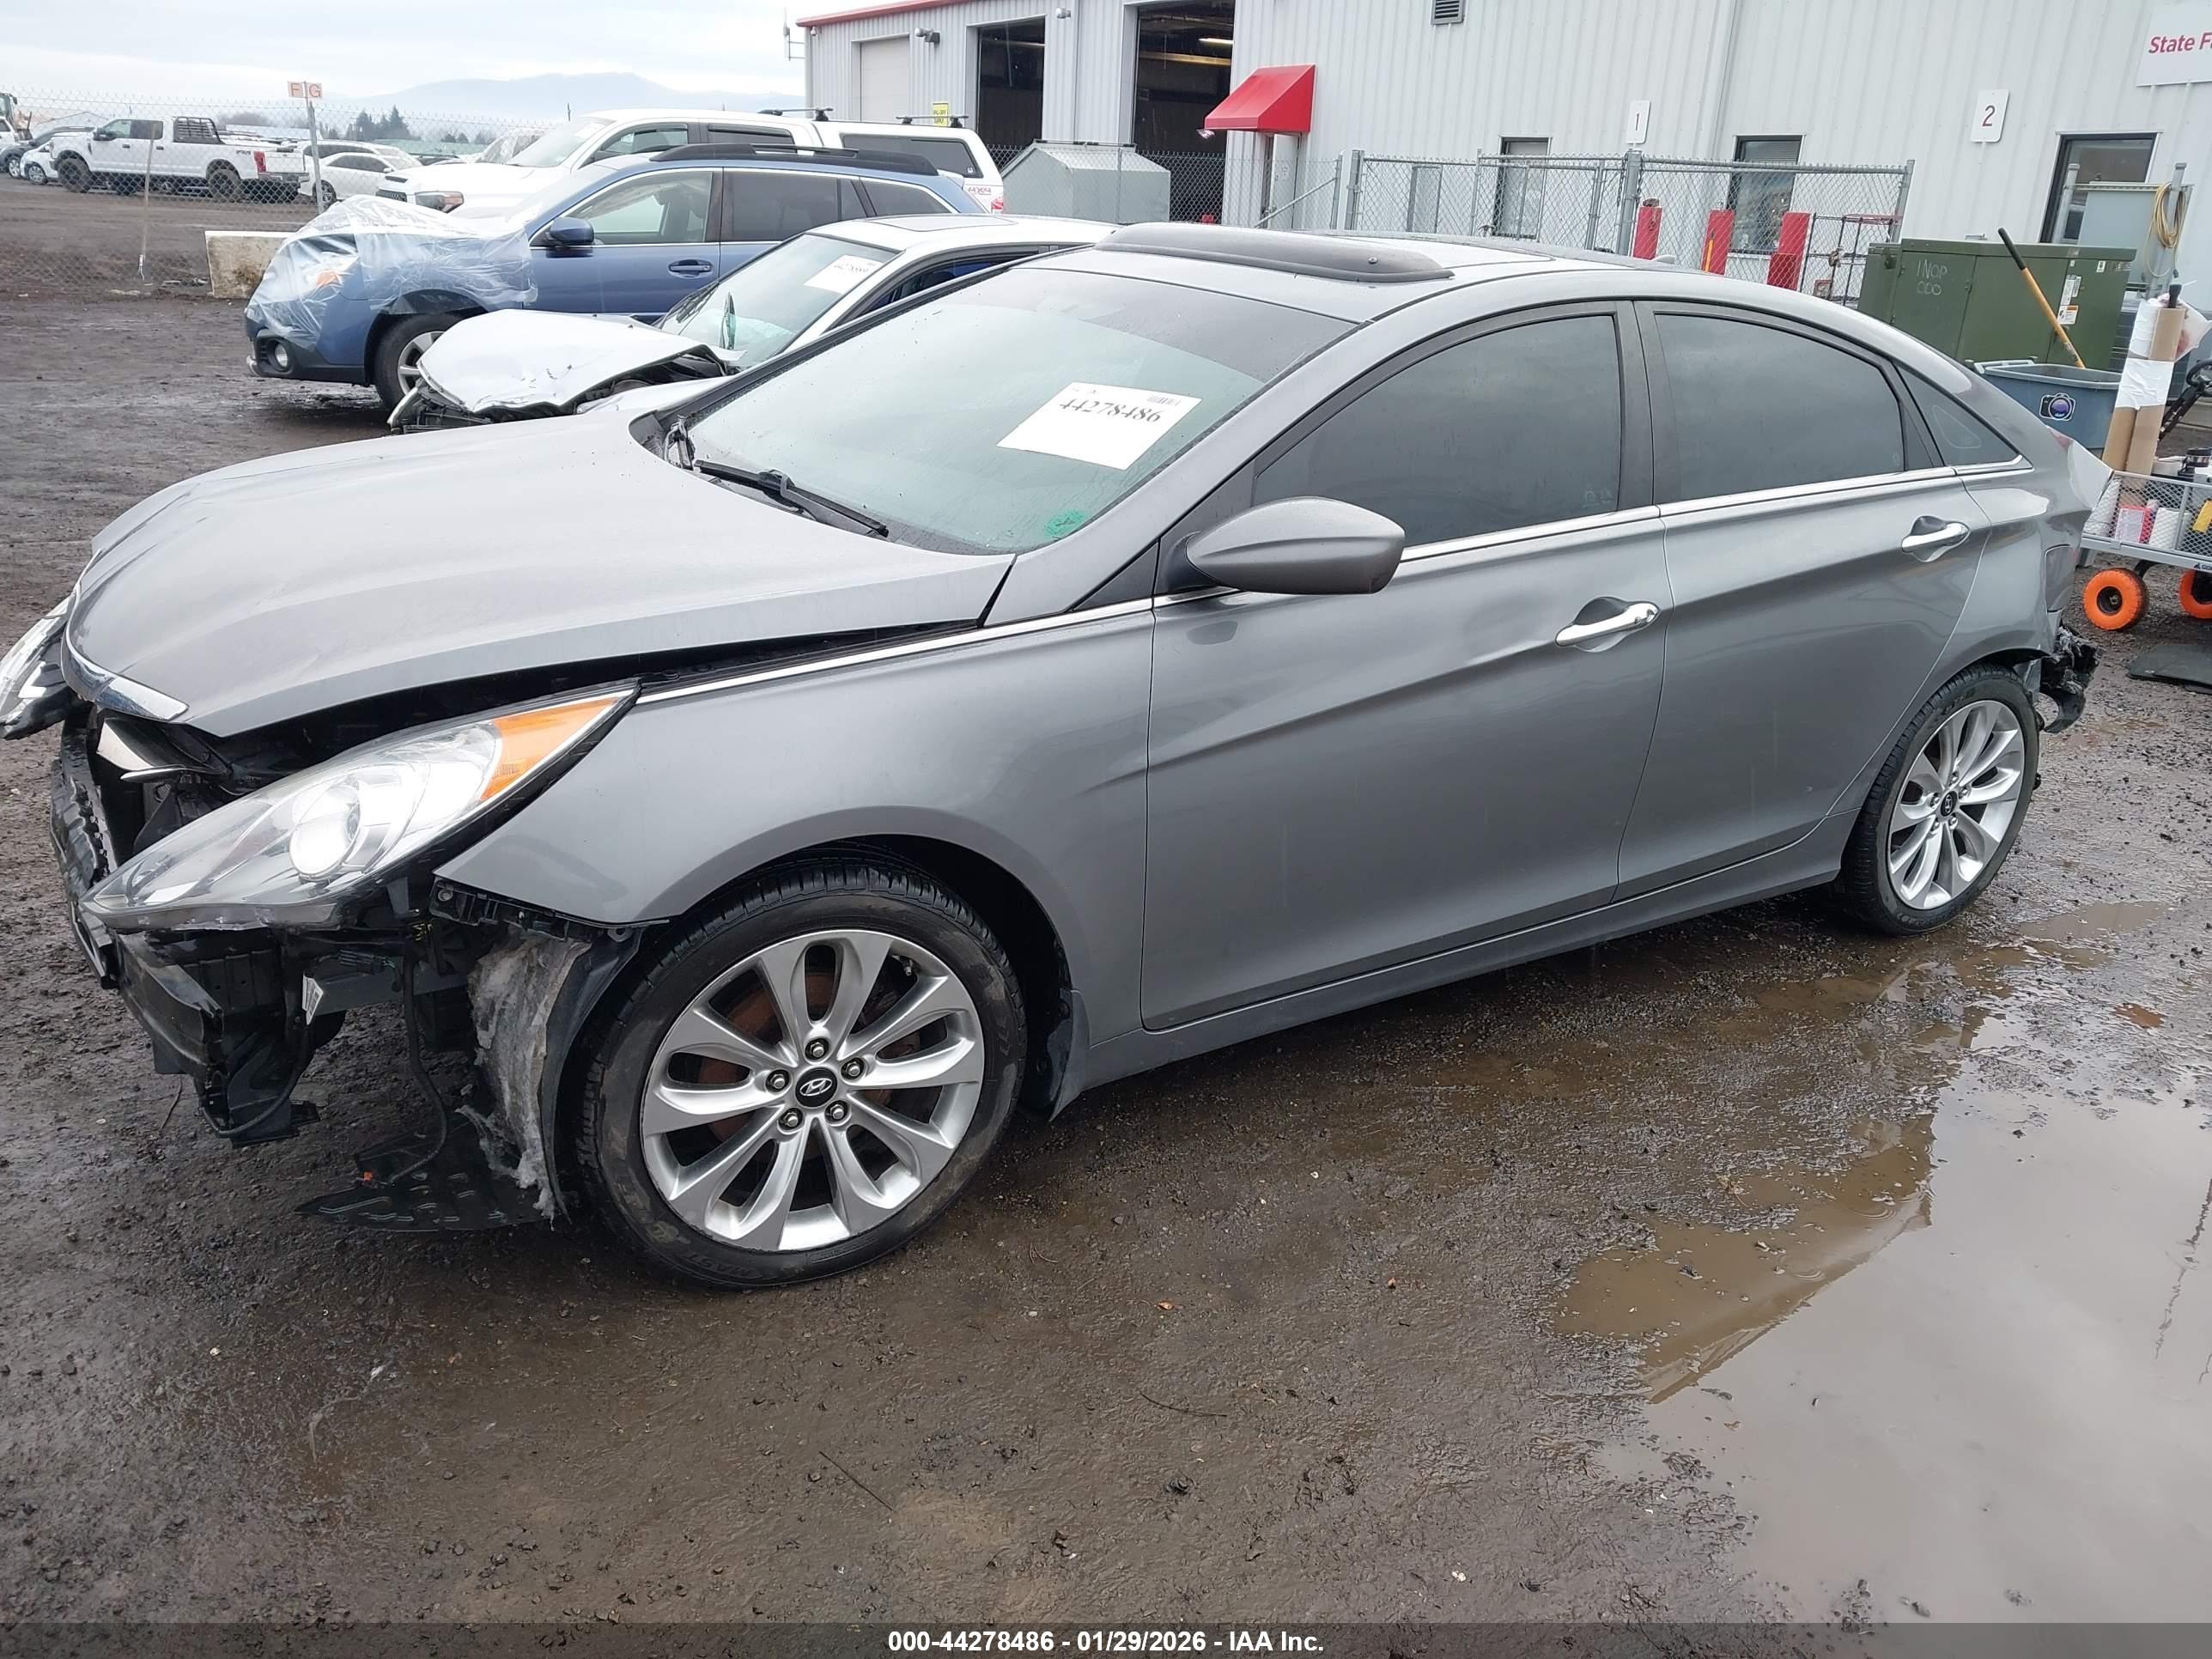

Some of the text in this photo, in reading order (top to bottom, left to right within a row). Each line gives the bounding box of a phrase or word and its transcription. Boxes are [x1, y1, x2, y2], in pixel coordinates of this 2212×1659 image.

[2148, 32, 2212, 53] State F
[290, 82, 300, 96] F
[309, 83, 321, 98] G
[1635, 112, 1639, 131] 1
[1982, 105, 1996, 127] 2
[1060, 398, 1164, 422] 44278486
